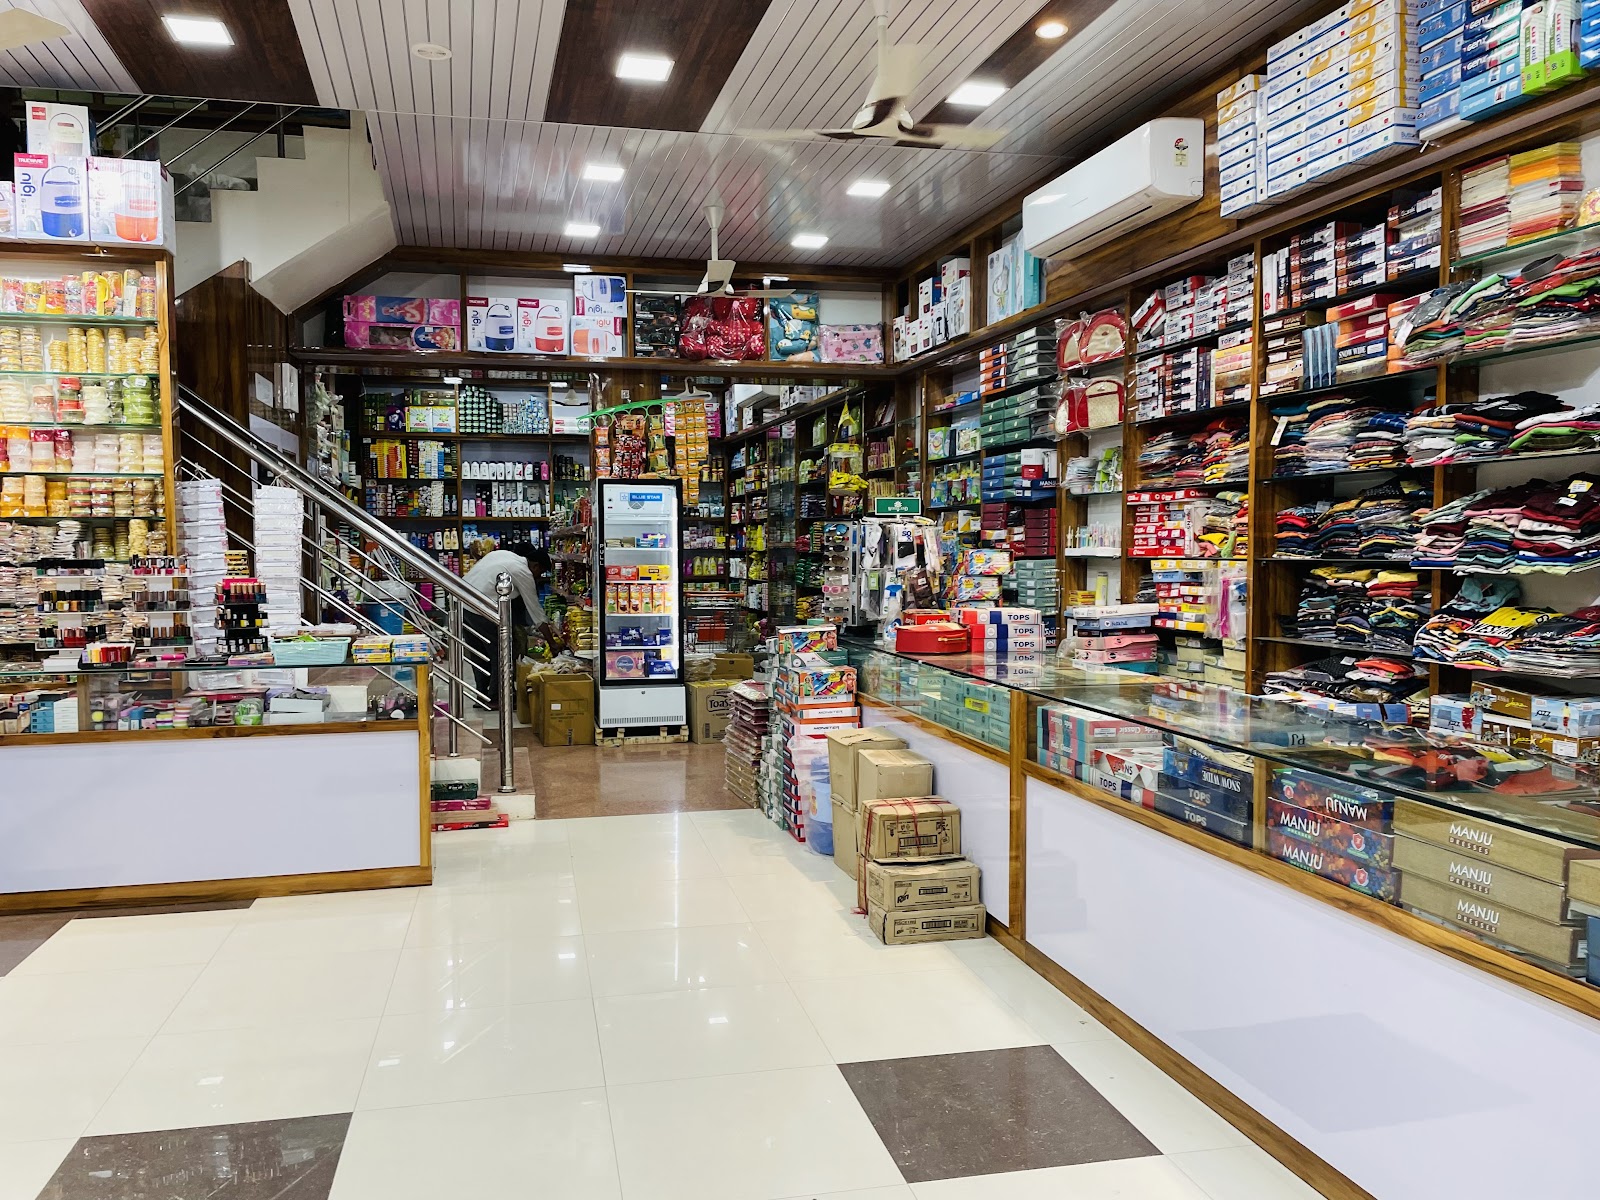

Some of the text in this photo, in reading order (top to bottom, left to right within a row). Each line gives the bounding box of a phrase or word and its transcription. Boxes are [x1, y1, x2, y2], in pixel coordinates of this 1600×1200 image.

[20, 173, 36, 197] iglu
[596, 320, 611, 328] iglu
[709, 699, 732, 709] Toas
[1119, 725, 1141, 734] Classic
[1100, 777, 1117, 791] TOPS
[1202, 770, 1241, 792] SNOW WIDE
[1188, 788, 1211, 804] TOPS
[1184, 810, 1207, 826] TOPS
[1325, 796, 1367, 821] MANJU
[1280, 811, 1321, 836] MANJU
[1449, 823, 1493, 846] MANJU
[1449, 837, 1489, 855] DRESSES
[1282, 844, 1324, 870] MANJU
[1449, 862, 1492, 885] MANJU
[1449, 876, 1489, 894] DRESSES
[1457, 899, 1499, 924] MANJU
[1457, 914, 1496, 933] DRESSES
